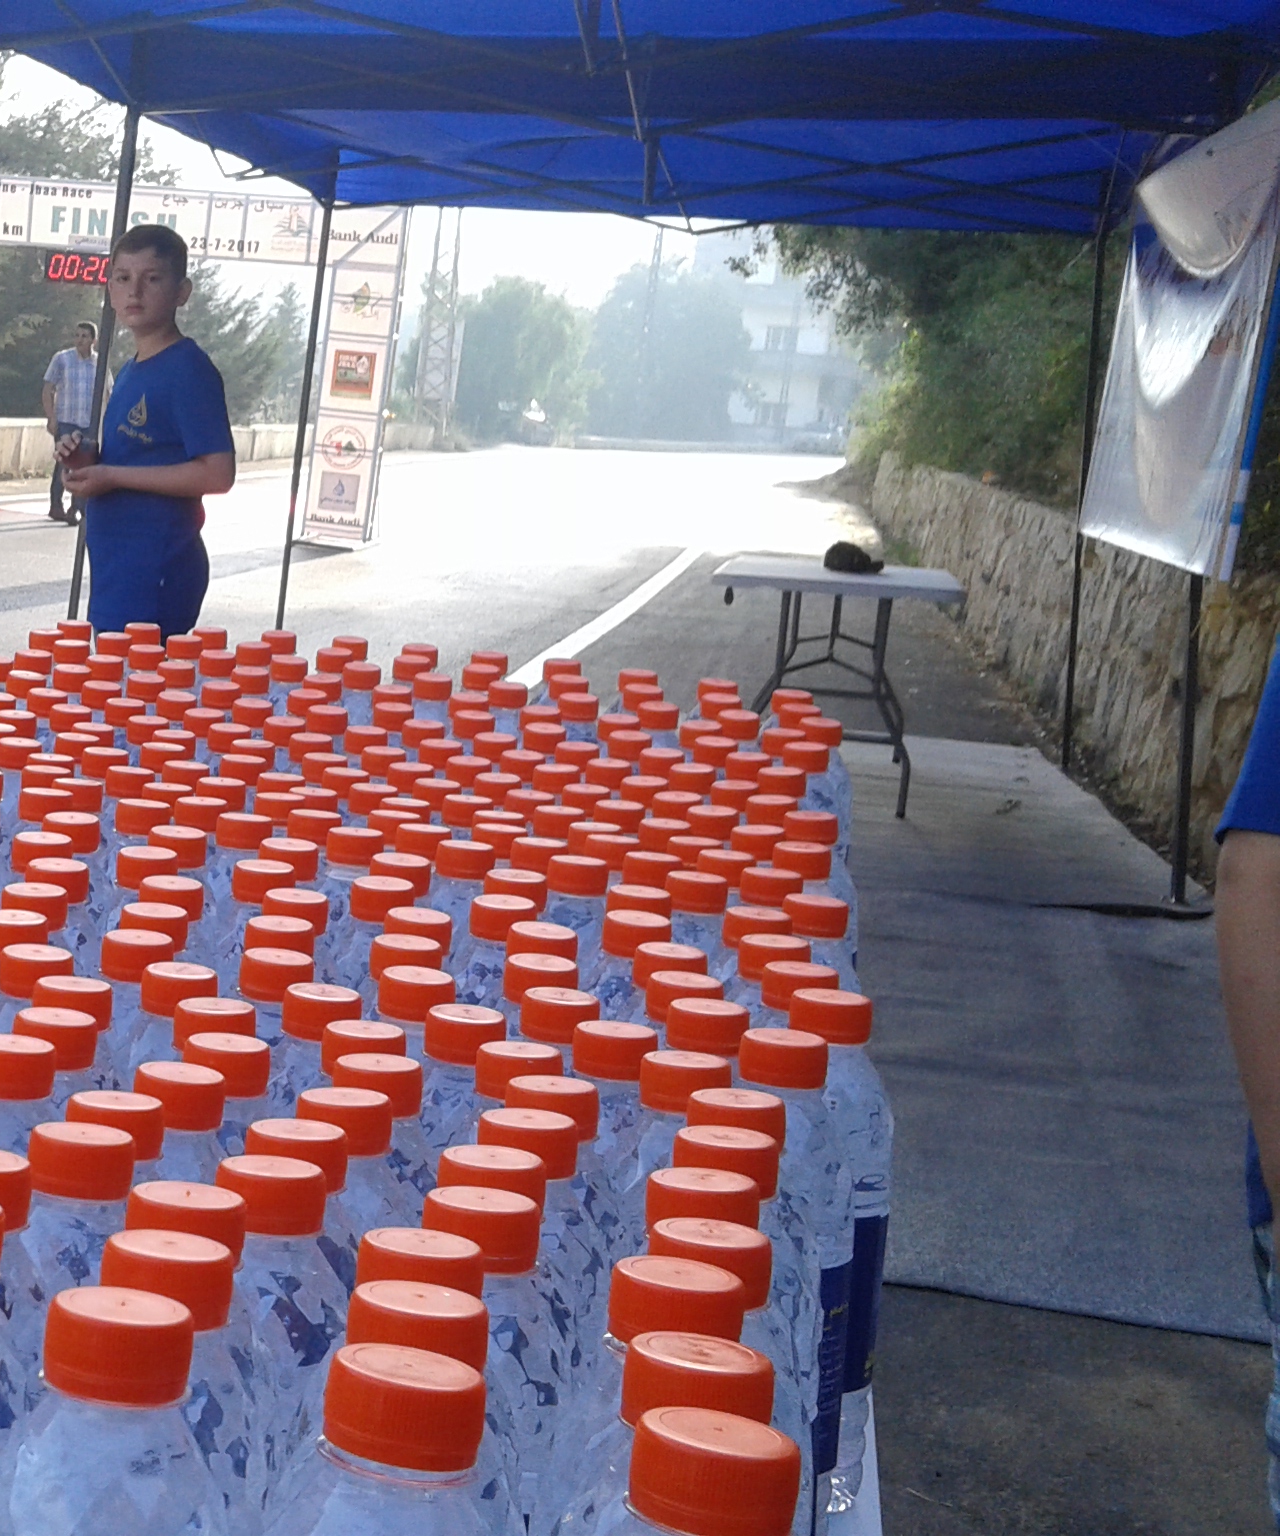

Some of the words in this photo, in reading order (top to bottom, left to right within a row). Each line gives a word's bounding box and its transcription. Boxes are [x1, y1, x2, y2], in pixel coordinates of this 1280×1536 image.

[62, 186, 93, 198] Race
[50, 205, 177, 236] FINSH
[3, 222, 23, 236] km
[327, 229, 361, 242] Bank
[366, 231, 399, 245] Audi
[190, 236, 261, 254] 23-7-2017
